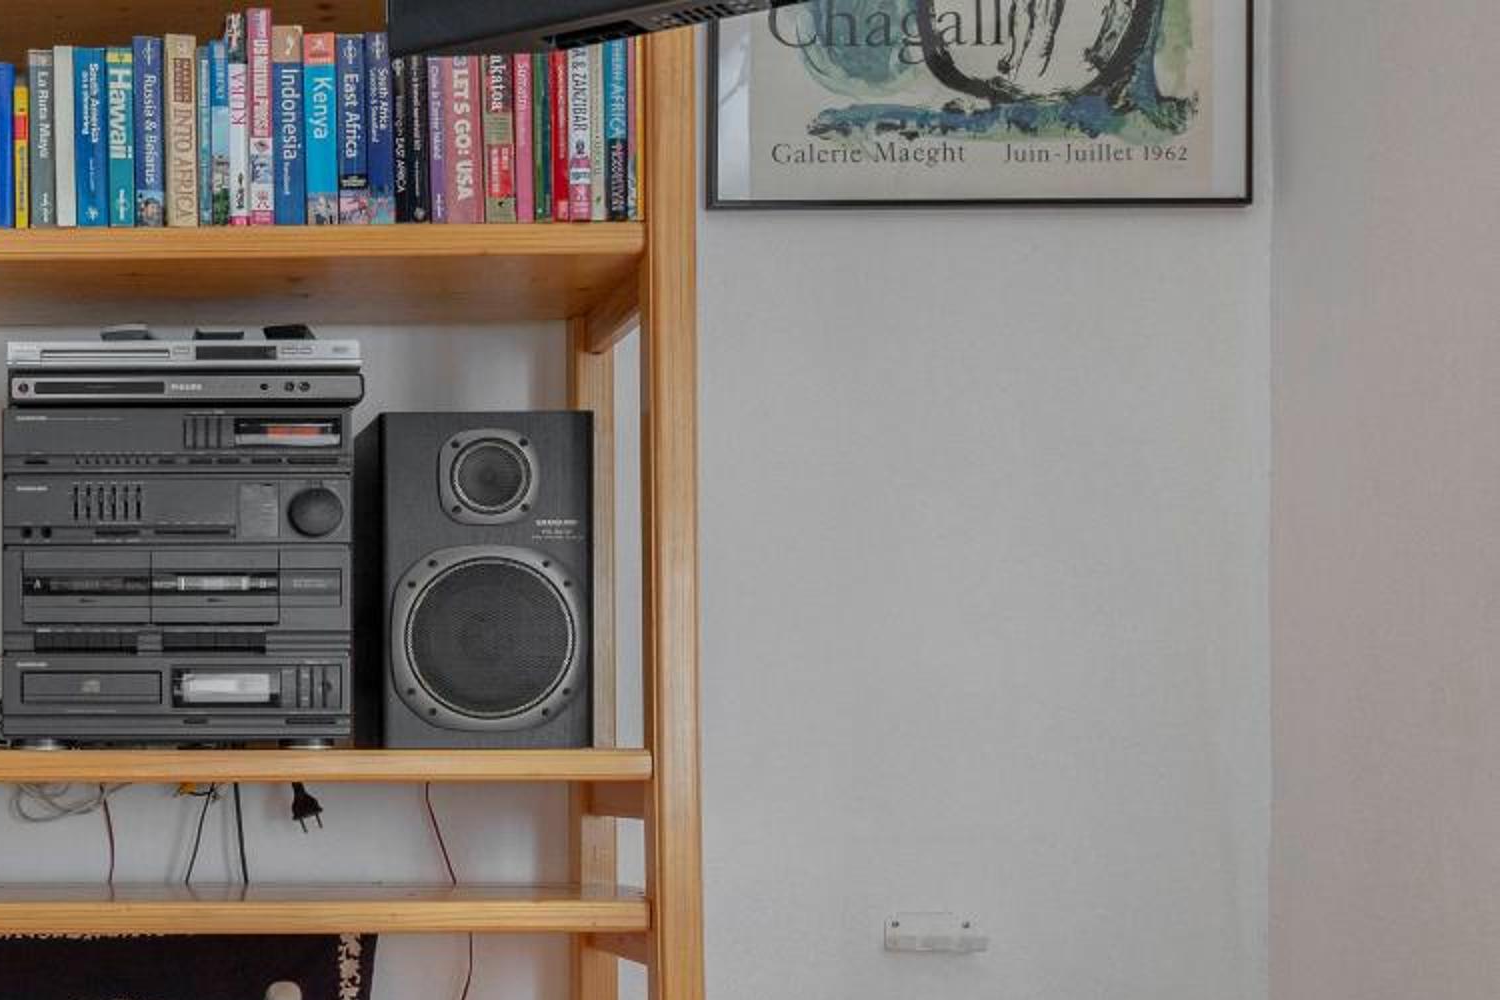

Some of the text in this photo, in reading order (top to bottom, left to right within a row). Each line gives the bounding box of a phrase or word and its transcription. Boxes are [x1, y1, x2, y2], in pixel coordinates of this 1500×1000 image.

[253, 39, 269, 53] US
[768, 0, 1004, 65] Chagall
[518, 63, 530, 111] Sumatra
[573, 61, 588, 72] &
[35, 70, 51, 159] La Ruta Maya
[88, 63, 101, 143] South America
[108, 67, 132, 159] Hawaii
[231, 72, 246, 126] KUBA
[282, 69, 300, 160] Indonesia
[308, 76, 333, 139] Kenya
[343, 73, 361, 158] East Africa
[378, 68, 389, 130] South Africa
[572, 73, 590, 132] ZANZIBAR
[608, 82, 627, 139] AFRICA
[142, 73, 158, 185] Russia & Belarus
[173, 102, 192, 154] INTO
[395, 137, 405, 158] EAST
[433, 131, 443, 160] Island
[454, 119, 471, 155] GO:
[771, 143, 862, 164] Galerie
[875, 141, 965, 167] Maeght
[1143, 144, 1188, 162] 1962
[174, 153, 194, 221] AFRICA
[396, 159, 406, 192] AFRICA
[456, 159, 474, 200] USA
